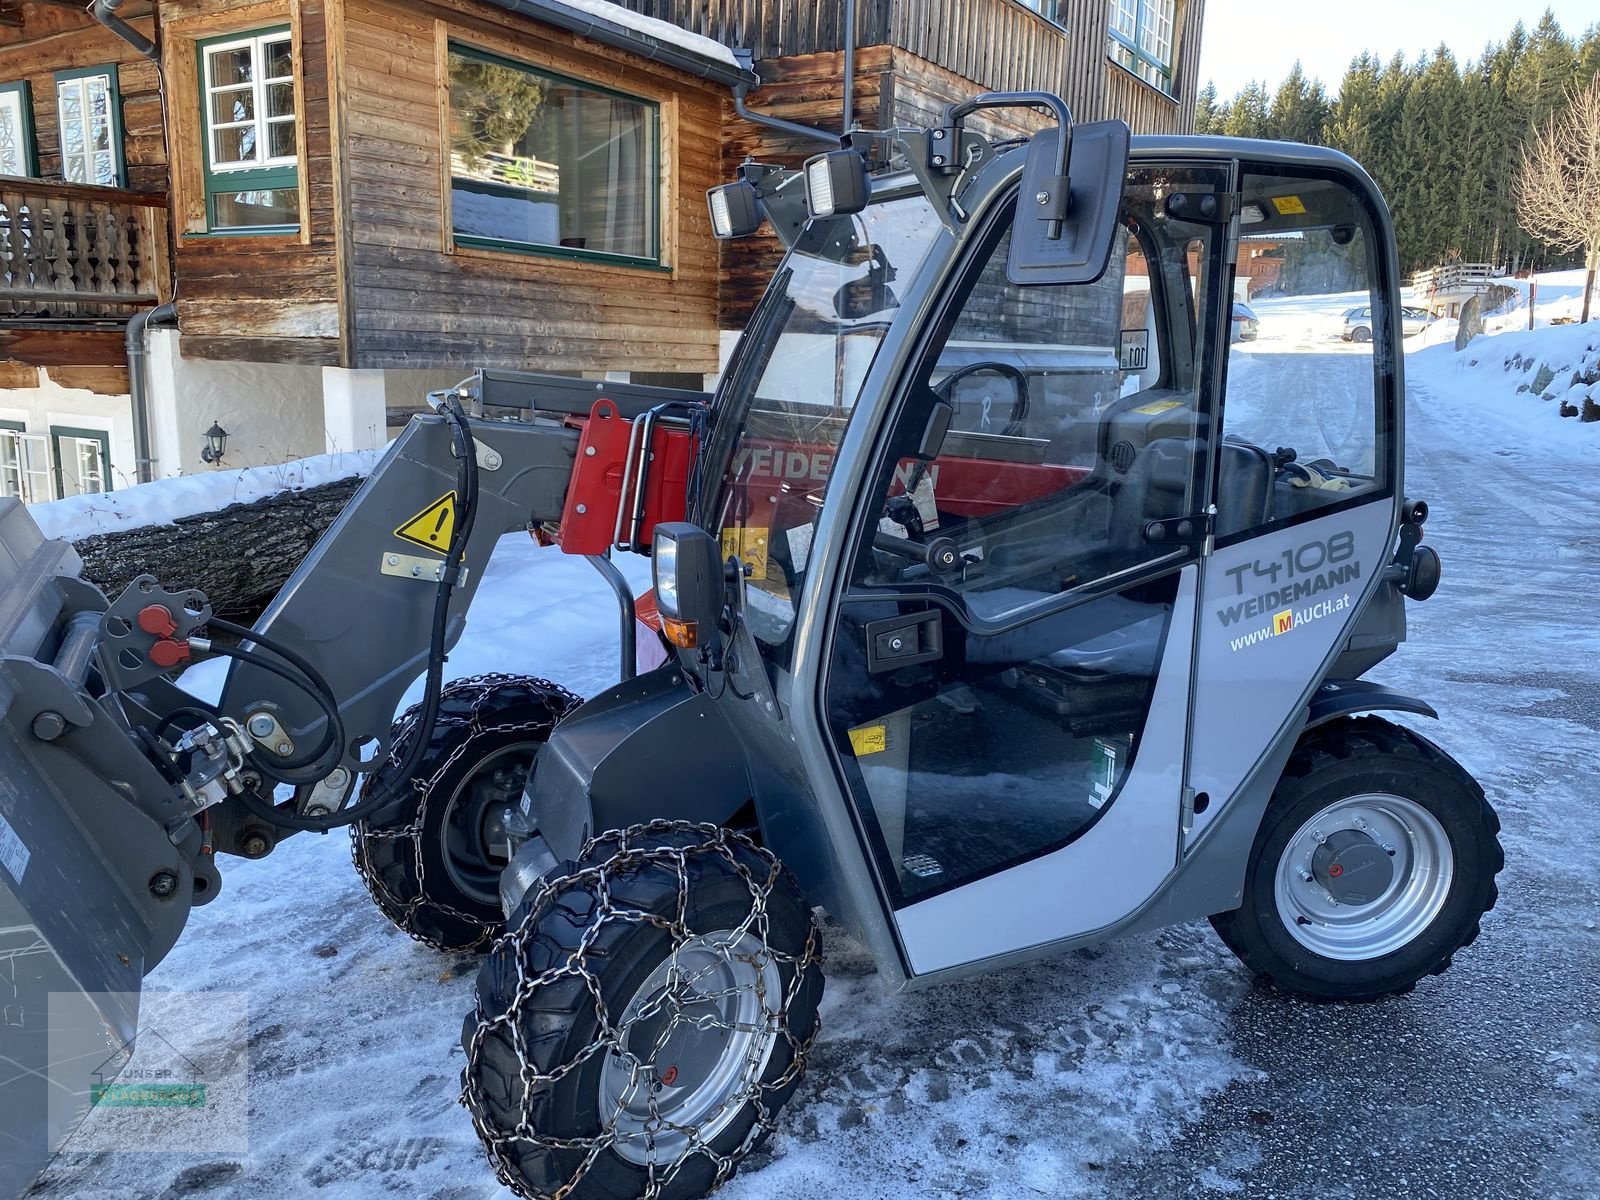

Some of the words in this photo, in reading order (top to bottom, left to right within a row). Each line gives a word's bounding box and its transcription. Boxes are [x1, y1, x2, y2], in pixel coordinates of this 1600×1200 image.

[1216, 561, 1361, 627] WEIDEMANN
[1225, 530, 1355, 595] T4108
[1230, 593, 1350, 651] www.MAUCH.at
